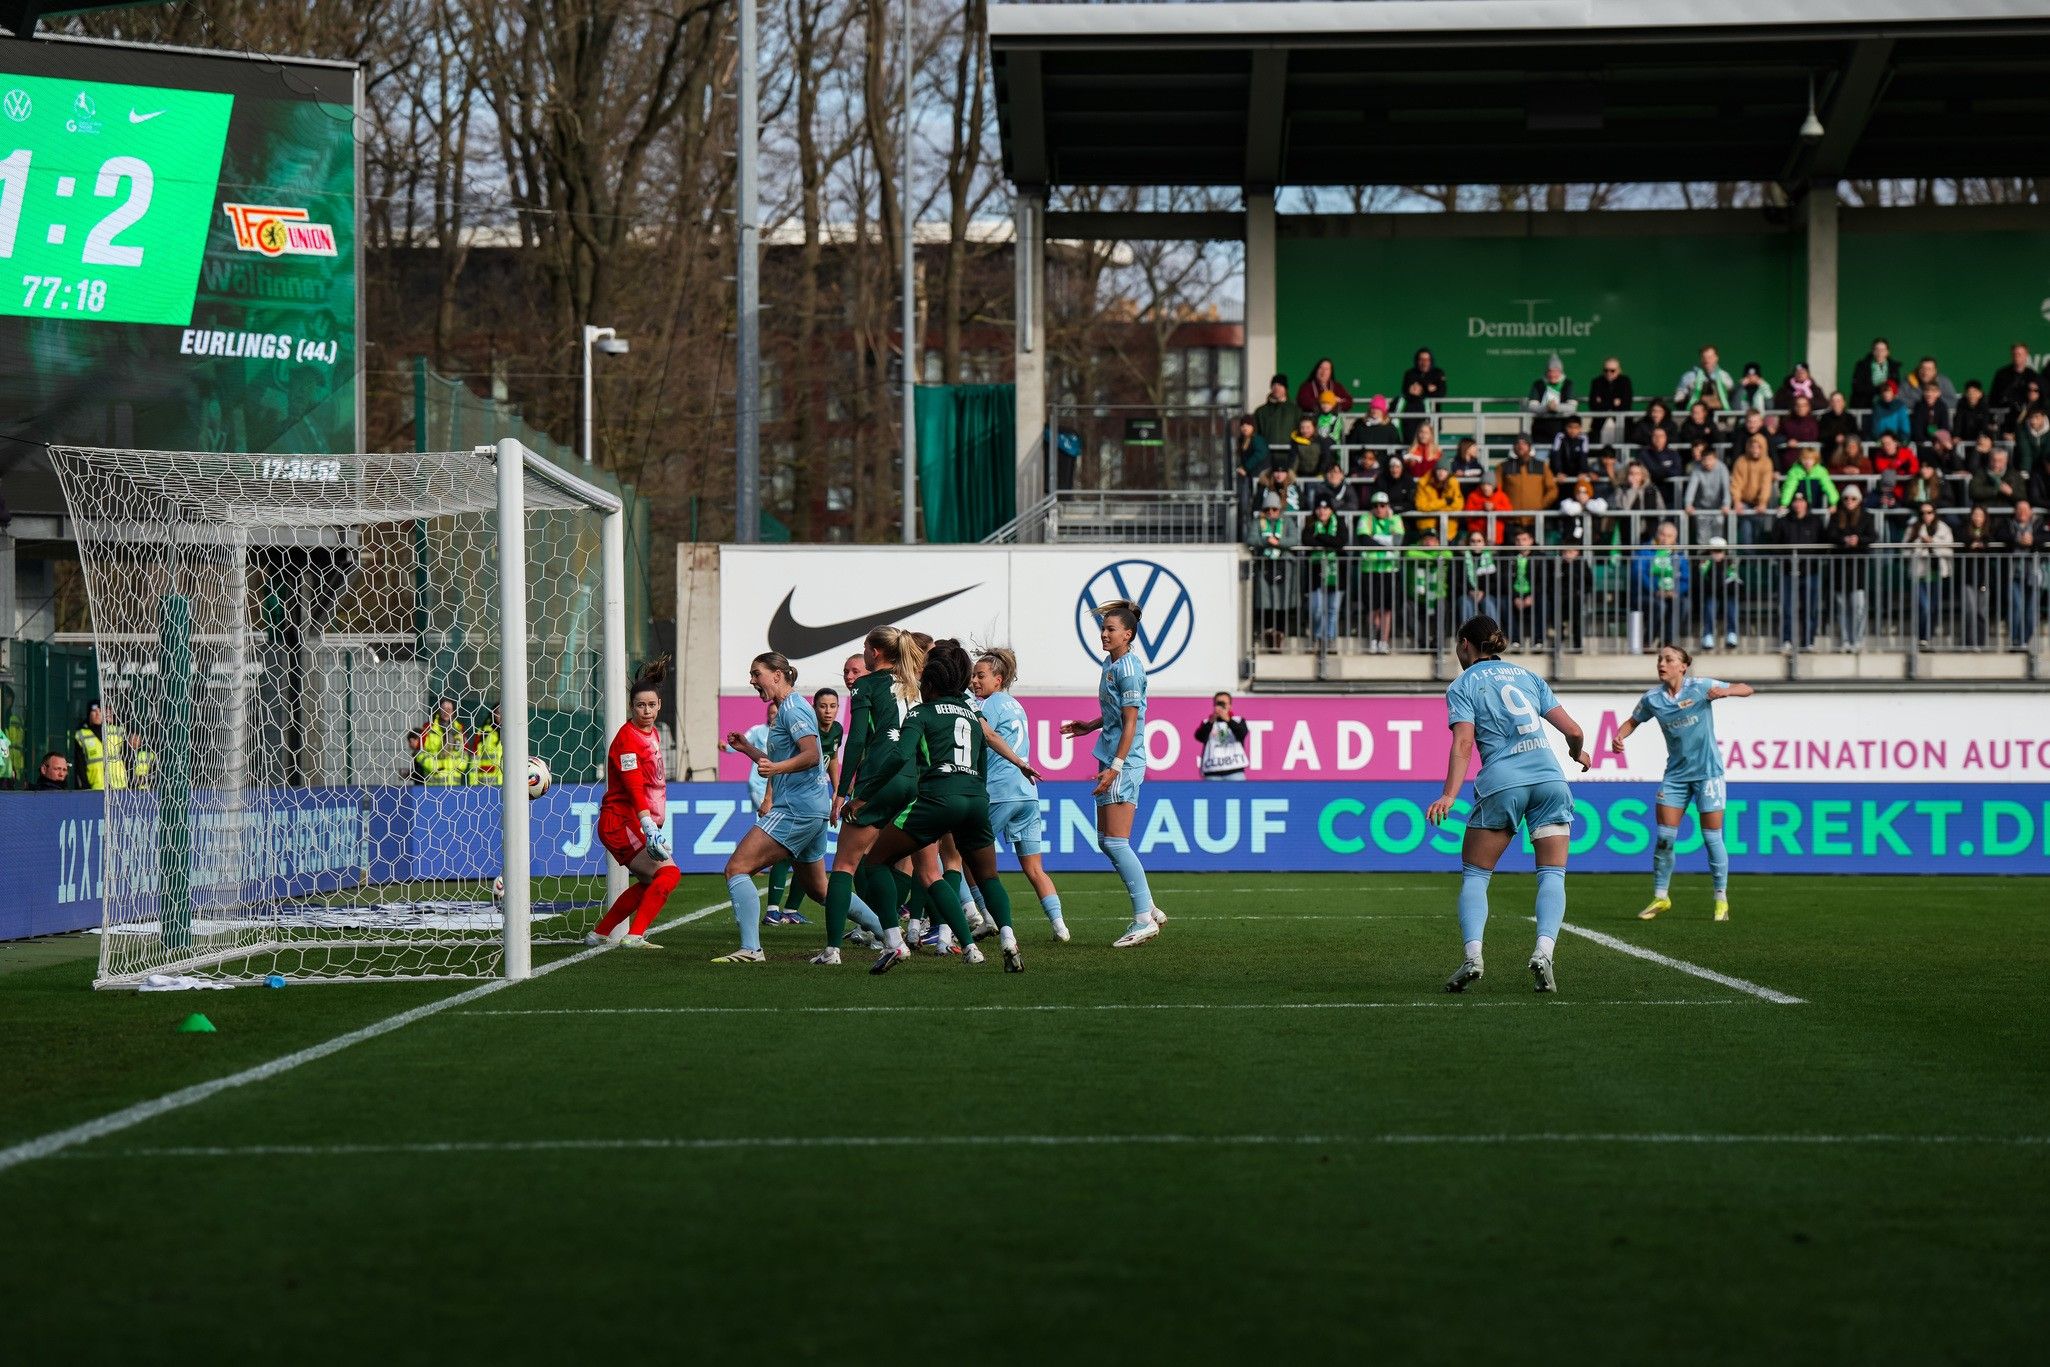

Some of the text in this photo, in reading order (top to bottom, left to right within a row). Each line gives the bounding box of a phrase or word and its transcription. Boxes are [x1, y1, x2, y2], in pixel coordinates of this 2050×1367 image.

[288, 227, 332, 250] UNION
[22, 275, 107, 312] 77:18
[180, 329, 338, 365] EURLINGS (44.)
[1482, 667, 1497, 677] FC
[1497, 667, 1527, 676] UNION
[1501, 684, 1540, 735] 9
[953, 717, 972, 768] 9
[1592, 710, 1627, 768] A
[1717, 739, 1946, 769] ASZINATION
[1139, 799, 1290, 854] AUF
[58, 818, 76, 904] 12
